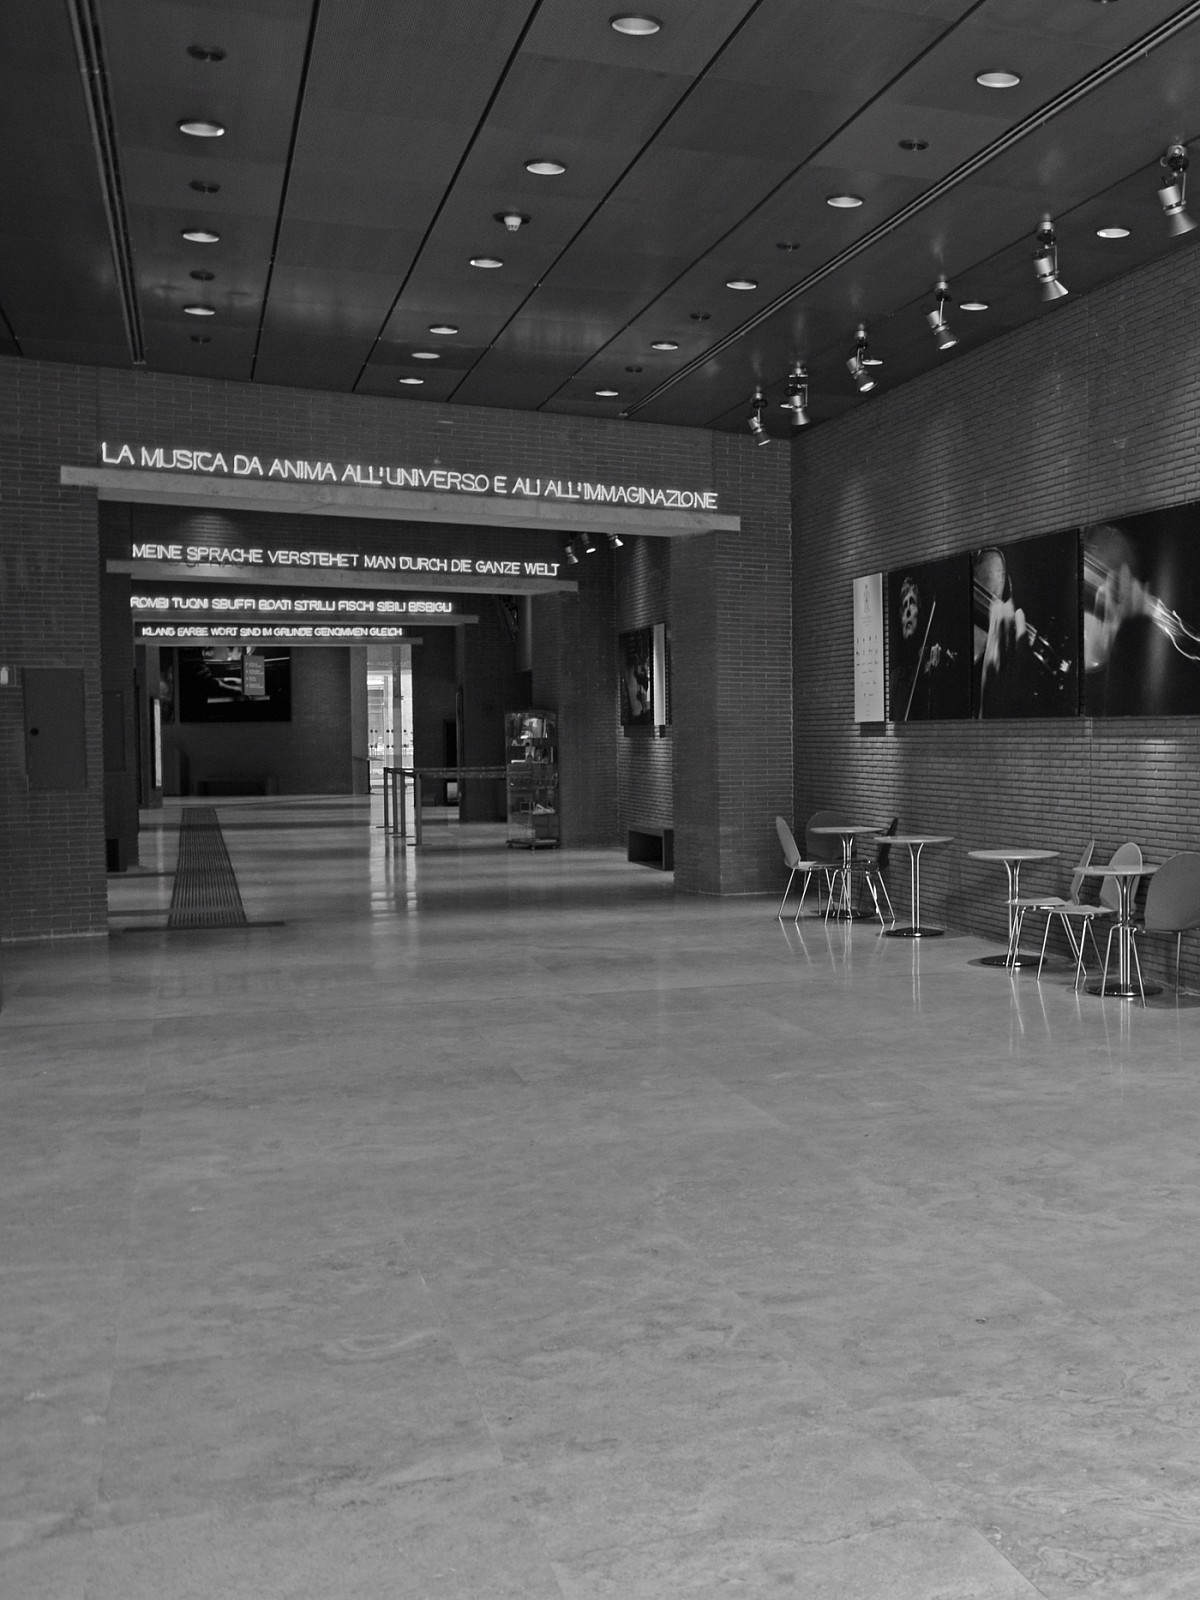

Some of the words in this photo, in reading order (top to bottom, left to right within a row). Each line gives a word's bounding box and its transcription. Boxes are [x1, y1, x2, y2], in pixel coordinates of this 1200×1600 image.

[102, 441, 135, 466] LA
[141, 446, 228, 473] MUSICA
[233, 454, 264, 477] DA
[268, 458, 338, 482] ANIMA
[341, 463, 489, 493] ALL'UNIVERSO
[494, 475, 508, 494] E
[511, 477, 541, 497] ALI
[544, 479, 719, 509] ALL'IMMAGINAZIONE
[131, 543, 183, 560] MEINE
[186, 546, 264, 563] SPRACHE
[267, 550, 360, 567] VERSTEHET
[364, 554, 396, 570] MAN
[399, 556, 448, 572] DURCH
[450, 558, 473, 573] DIE
[475, 560, 521, 575] GANZE
[524, 562, 560, 577] WELT
[130, 595, 169, 609] ROMBI
[211, 598, 256, 611] SBUFFI
[258, 598, 292, 611] BOATI
[294, 600, 336, 612] STRILLI
[338, 600, 375, 613] FISCHI
[376, 601, 406, 613] SIBILI
[408, 601, 453, 613] BISBIGLI
[141, 626, 176, 637] KLANG
[210, 626, 239, 637] WORT
[240, 627, 261, 637] SIND
[262, 627, 272, 637] IM
[273, 627, 313, 637] GRUNDE
[314, 627, 368, 637] GENOMMEN
[369, 627, 403, 637] GLEICH
